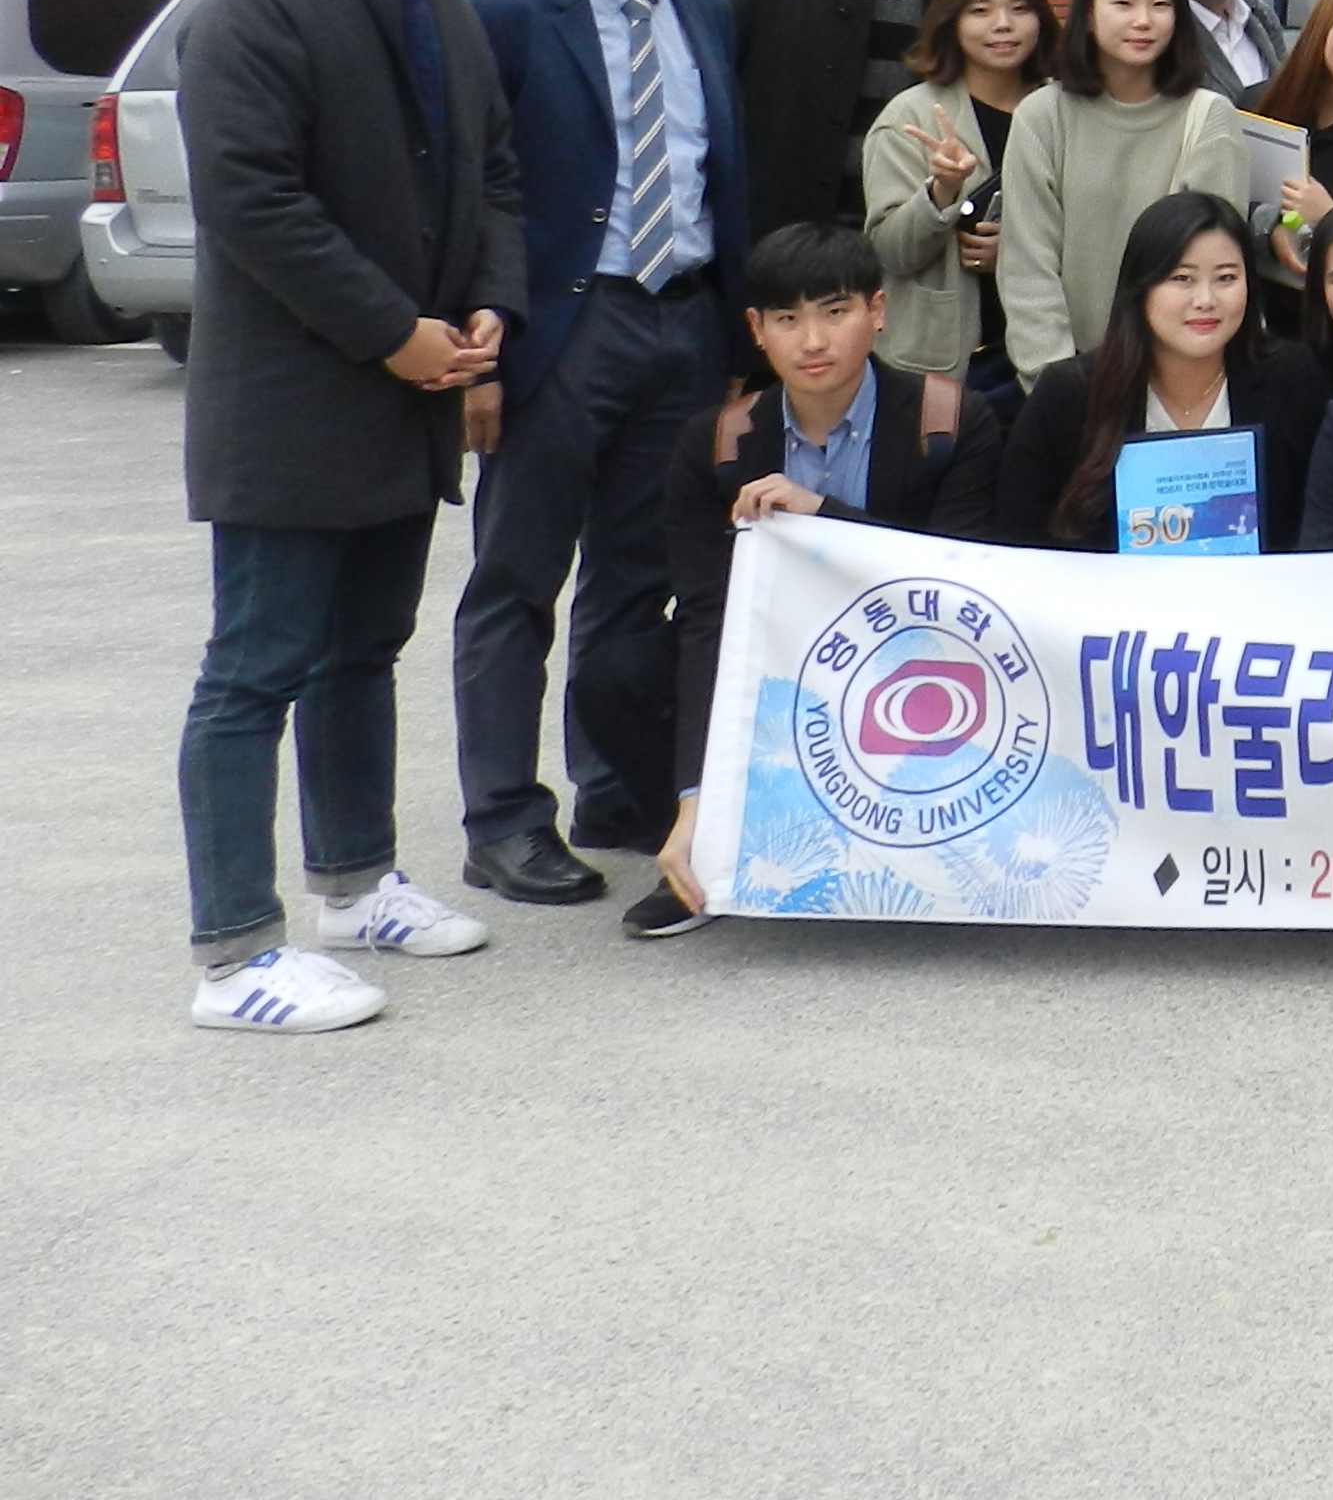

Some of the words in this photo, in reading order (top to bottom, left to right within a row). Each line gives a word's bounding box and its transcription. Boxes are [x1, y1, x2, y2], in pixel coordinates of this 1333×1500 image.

[1128, 504, 1191, 549] 50
[816, 589, 1030, 683] 영동대학교
[804, 700, 904, 835] YOUNGDONG
[917, 713, 1040, 835] UNIVERSITY
[1201, 845, 1267, 906] 일시
